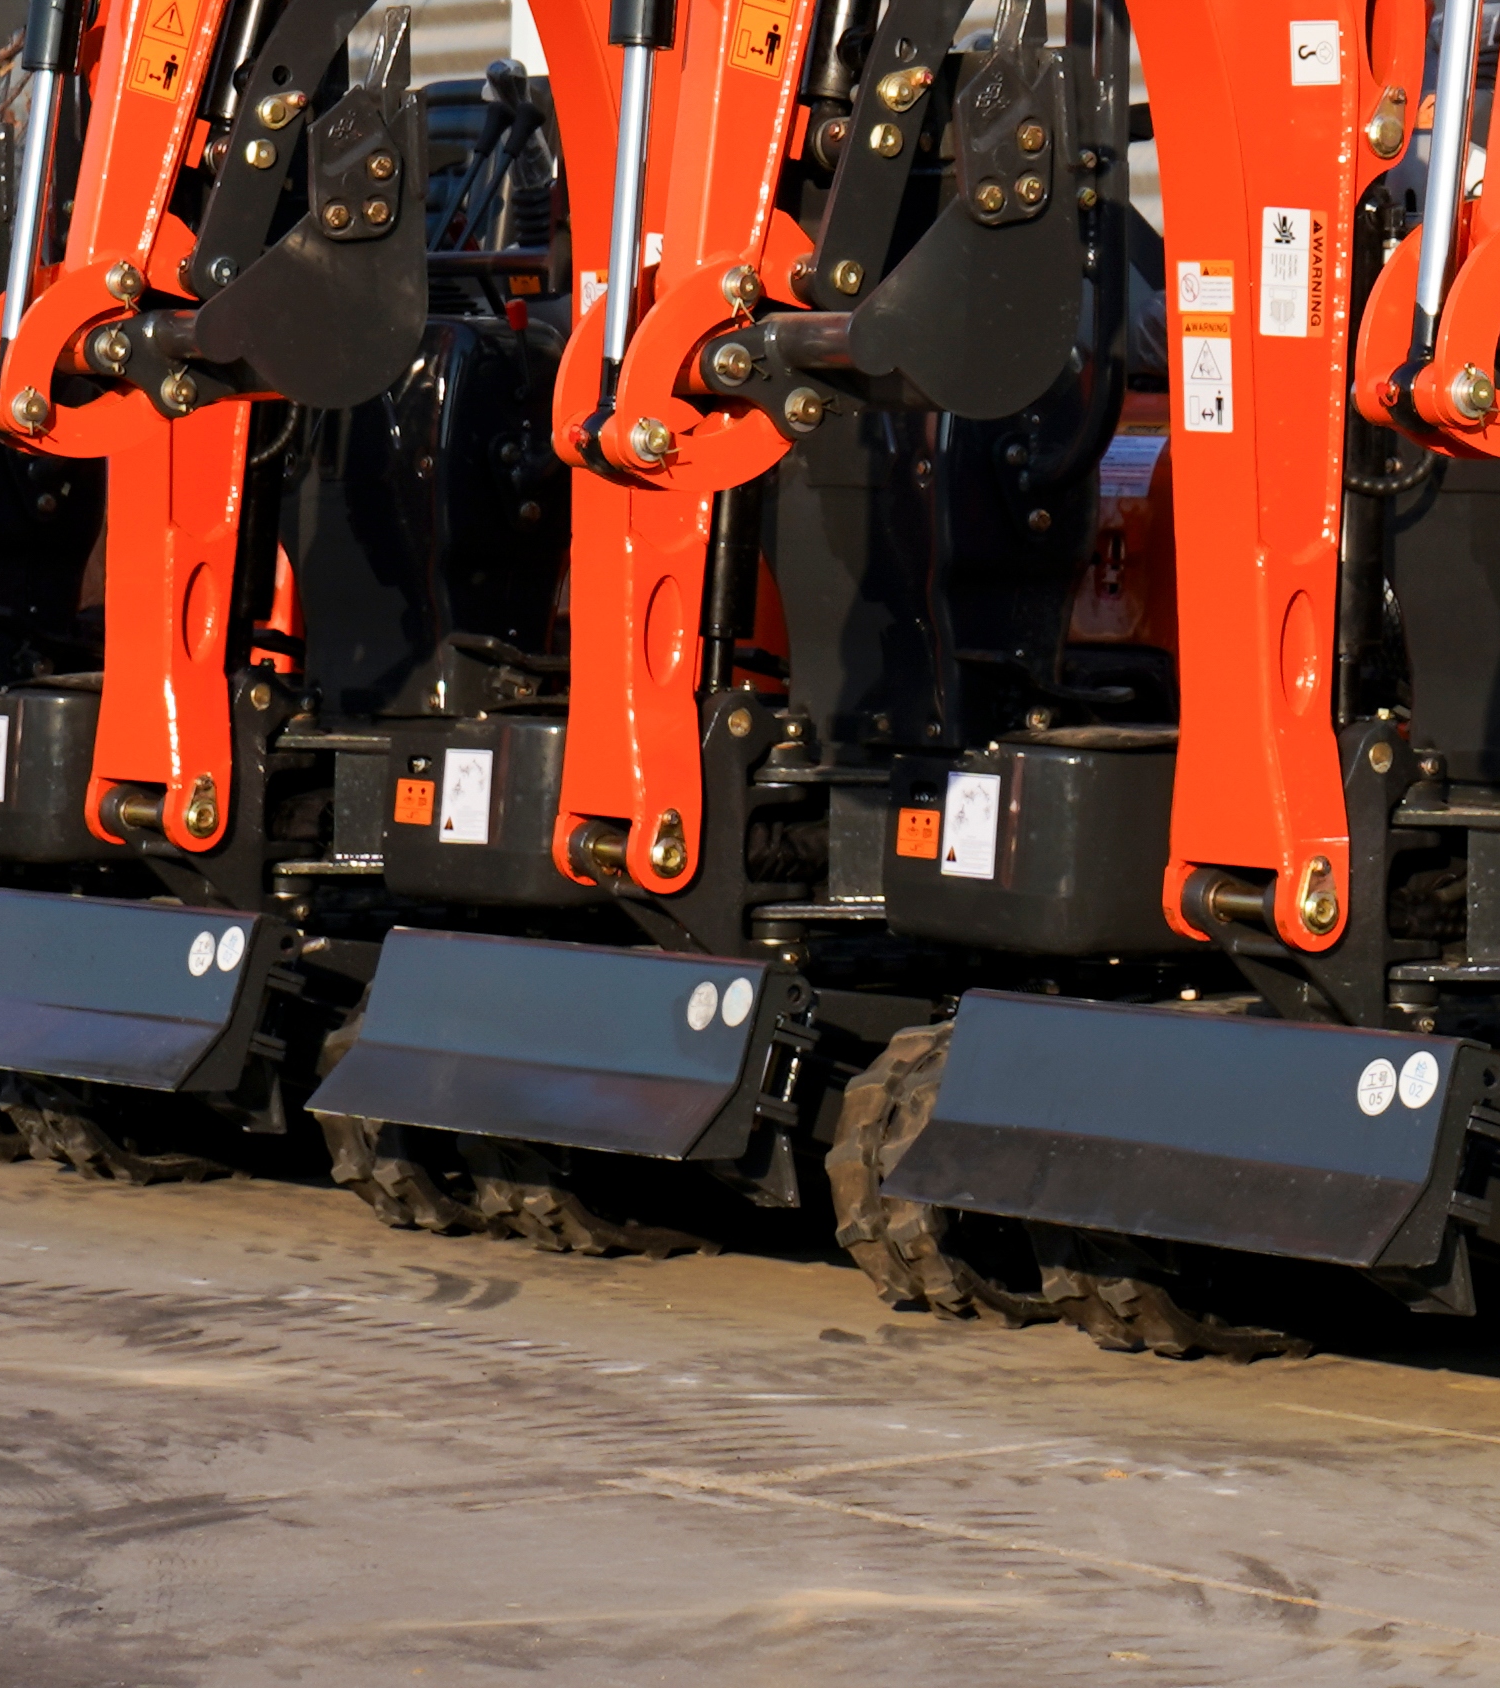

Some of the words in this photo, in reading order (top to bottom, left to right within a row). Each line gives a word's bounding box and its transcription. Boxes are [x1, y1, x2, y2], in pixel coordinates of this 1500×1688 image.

[1310, 236, 1324, 327] WARNING
[1192, 322, 1228, 333] WARNING
[1367, 1070, 1389, 1088] 工号
[1408, 1082, 1424, 1098] 02
[1368, 1091, 1383, 1106] 05
